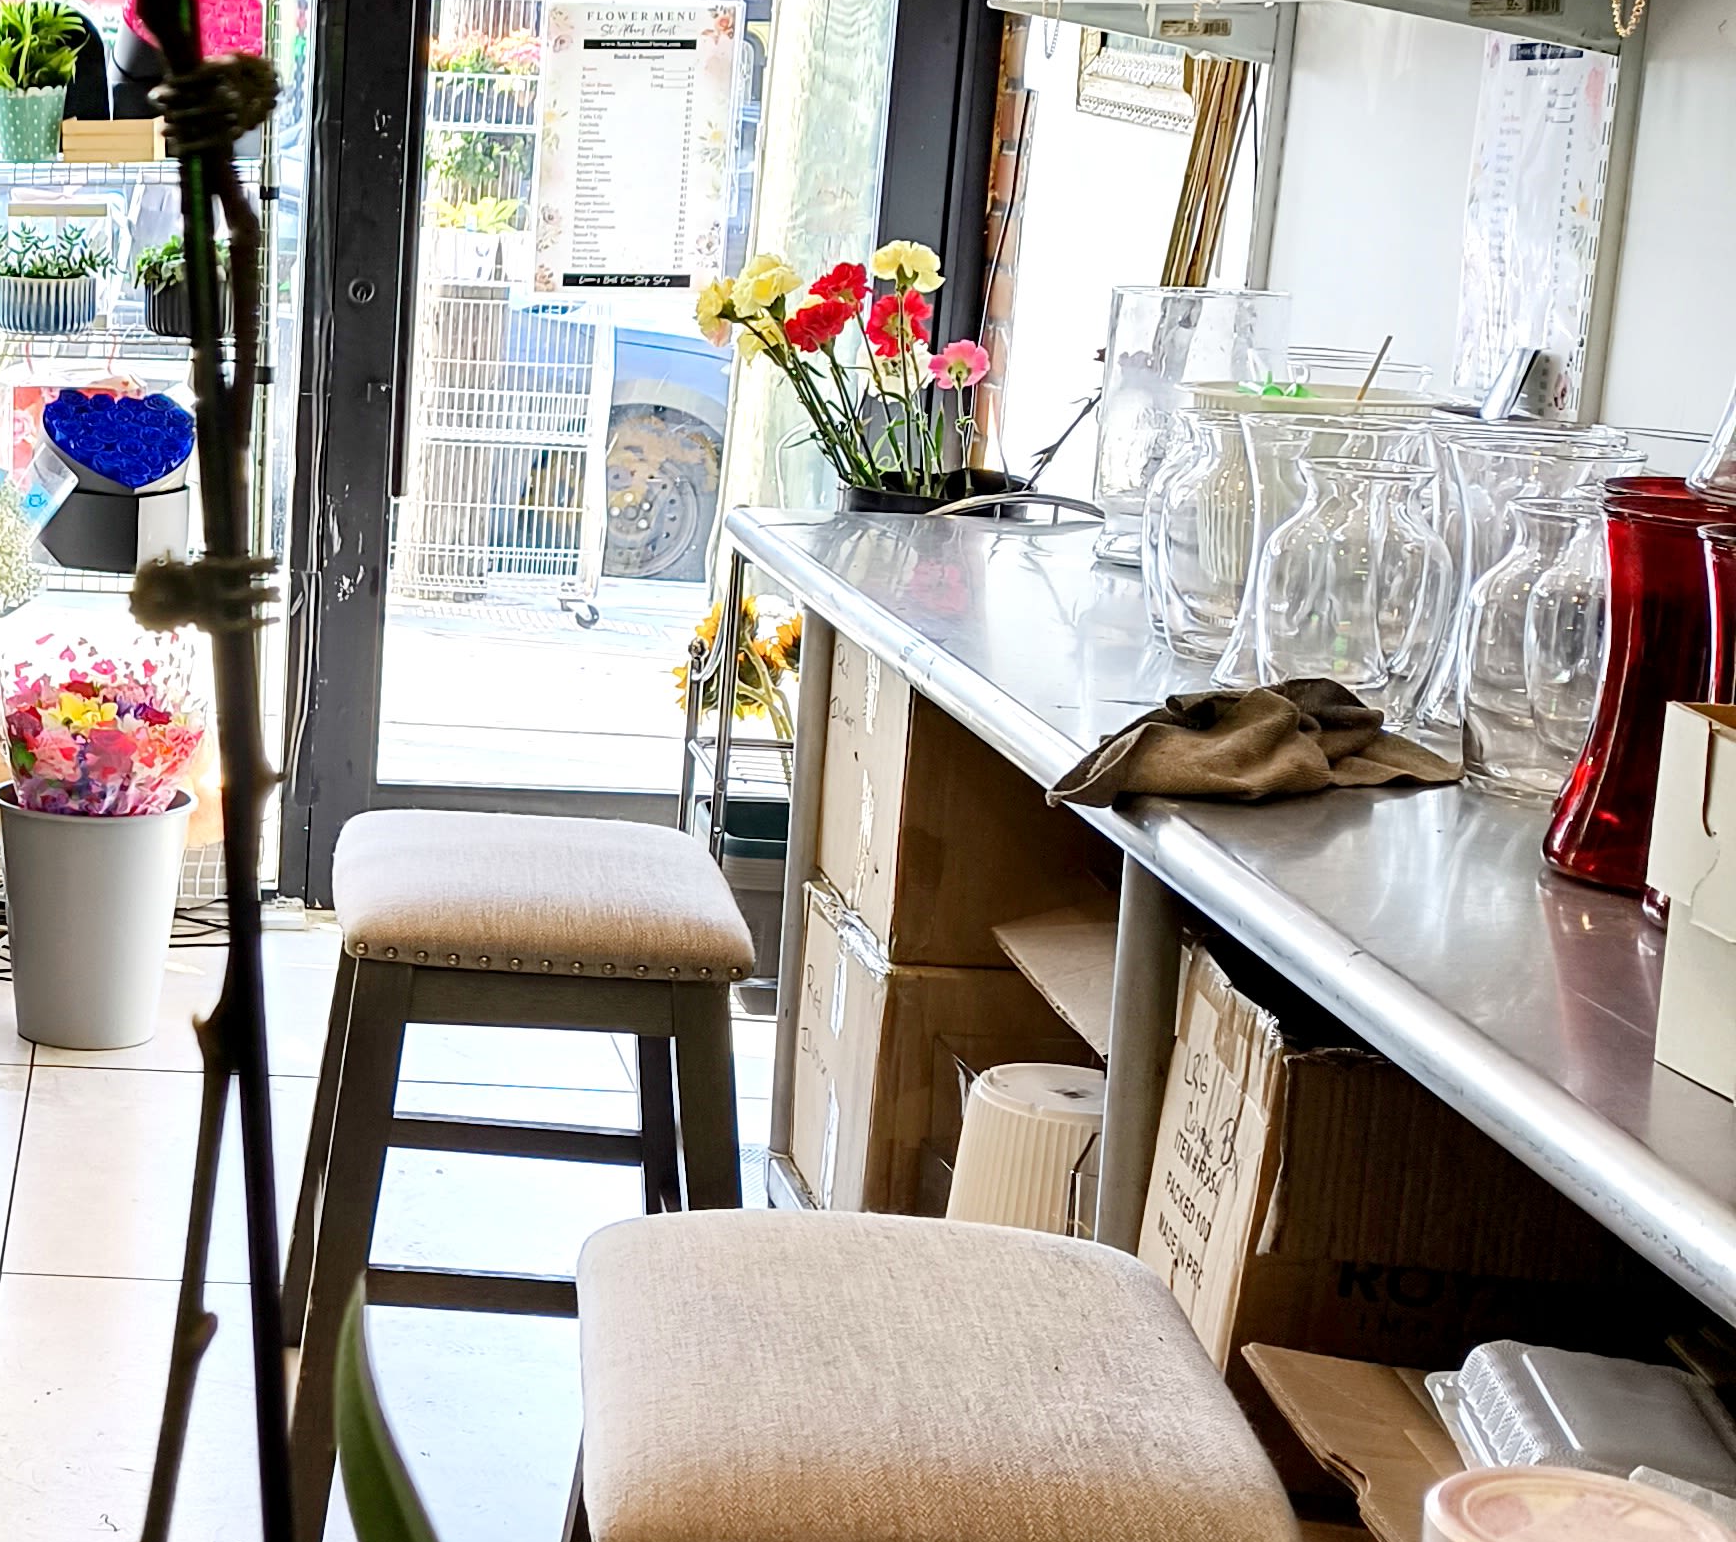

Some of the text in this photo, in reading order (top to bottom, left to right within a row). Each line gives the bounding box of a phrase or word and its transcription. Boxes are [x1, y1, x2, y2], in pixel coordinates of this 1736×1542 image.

[586, 11, 697, 21] FLOWER MENU
[1165, 1170, 1213, 1243] PACKED 100
[1157, 1210, 1177, 1257] MADE
[1185, 1259, 1205, 1290] PRC
